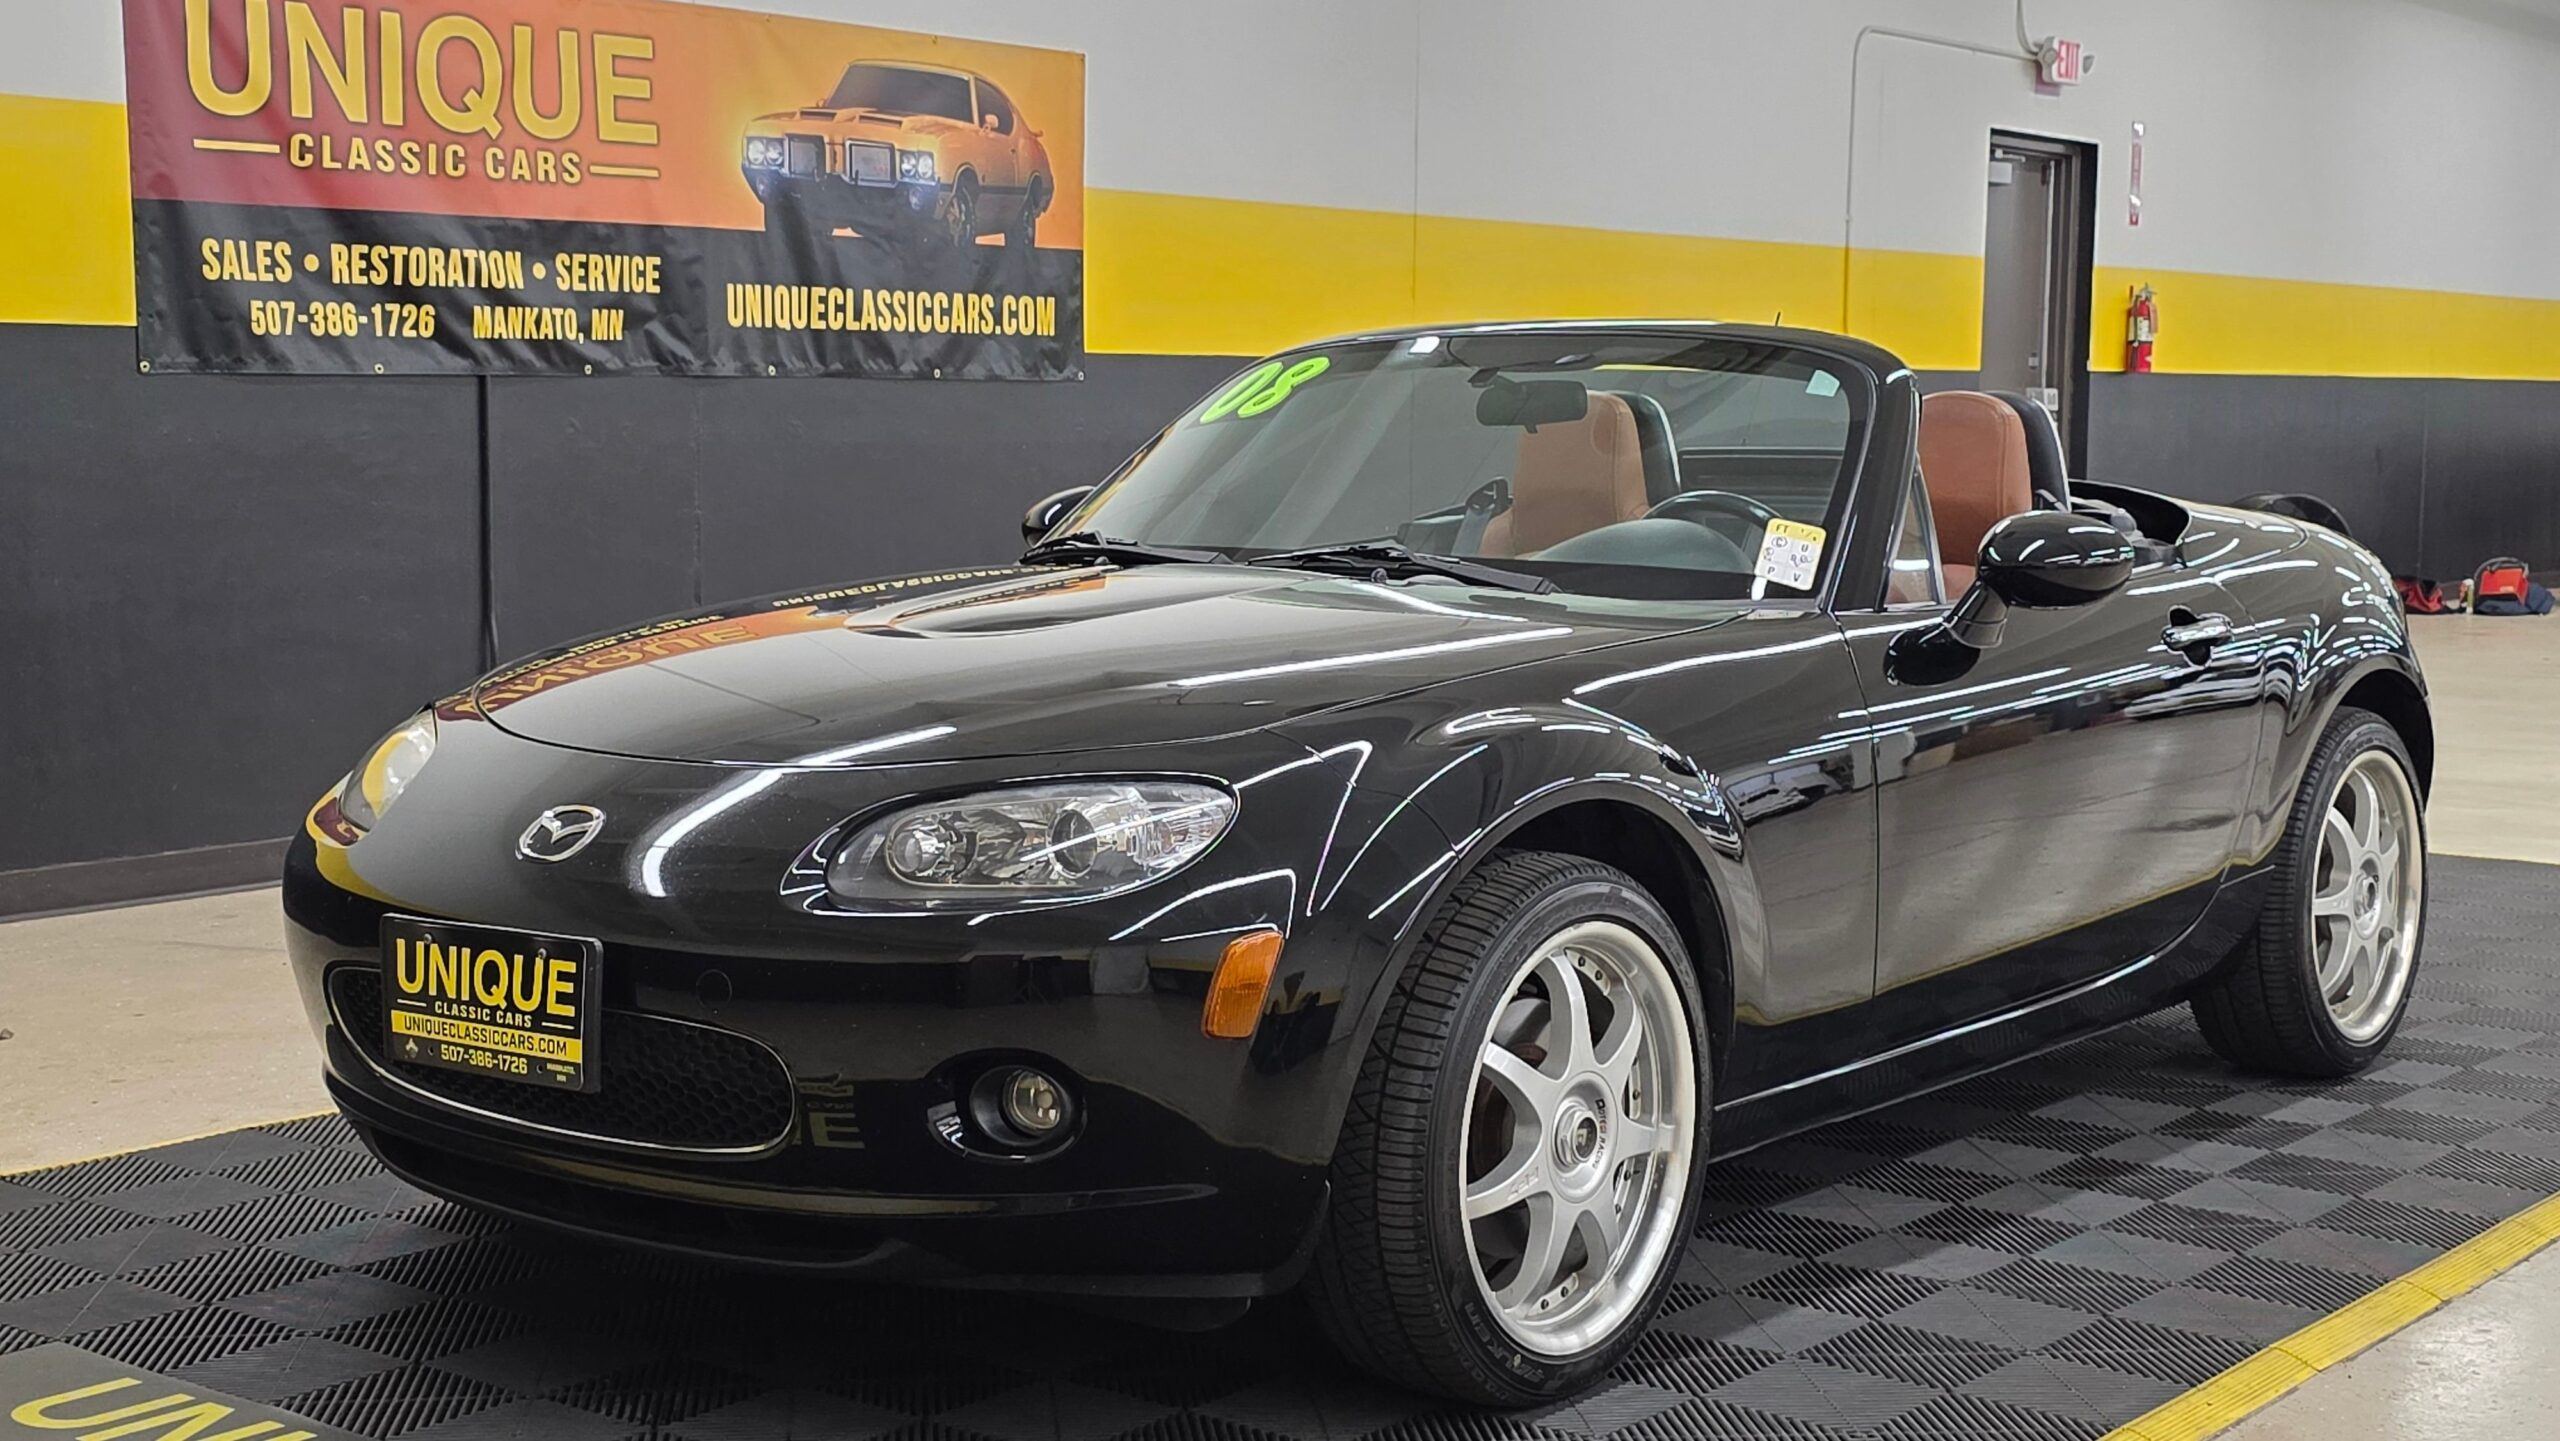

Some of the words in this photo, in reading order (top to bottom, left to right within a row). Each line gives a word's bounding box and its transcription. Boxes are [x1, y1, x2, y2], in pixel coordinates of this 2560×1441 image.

[186, 0, 659, 145] UNIQUE
[289, 132, 467, 178] CLASSIC
[484, 142, 583, 185] CARS
[201, 237, 293, 284] SALES
[330, 242, 525, 290] RESTORATION
[556, 252, 662, 295] SERVICE
[249, 299, 436, 339] 507-386-1726
[473, 305, 585, 345] MANKATO,
[591, 308, 624, 341] MN
[726, 281, 1057, 338] UNIQUECLASSICCARS.COM
[1200, 356, 1331, 424] 08
[396, 938, 577, 1018] UNIQUE
[403, 1014, 567, 1057] UNIQUECLASSICCARS.COM
[434, 1000, 491, 1022] CLASSIC
[496, 1011, 533, 1029] CARS
[440, 1043, 528, 1076] 507-386-1726
